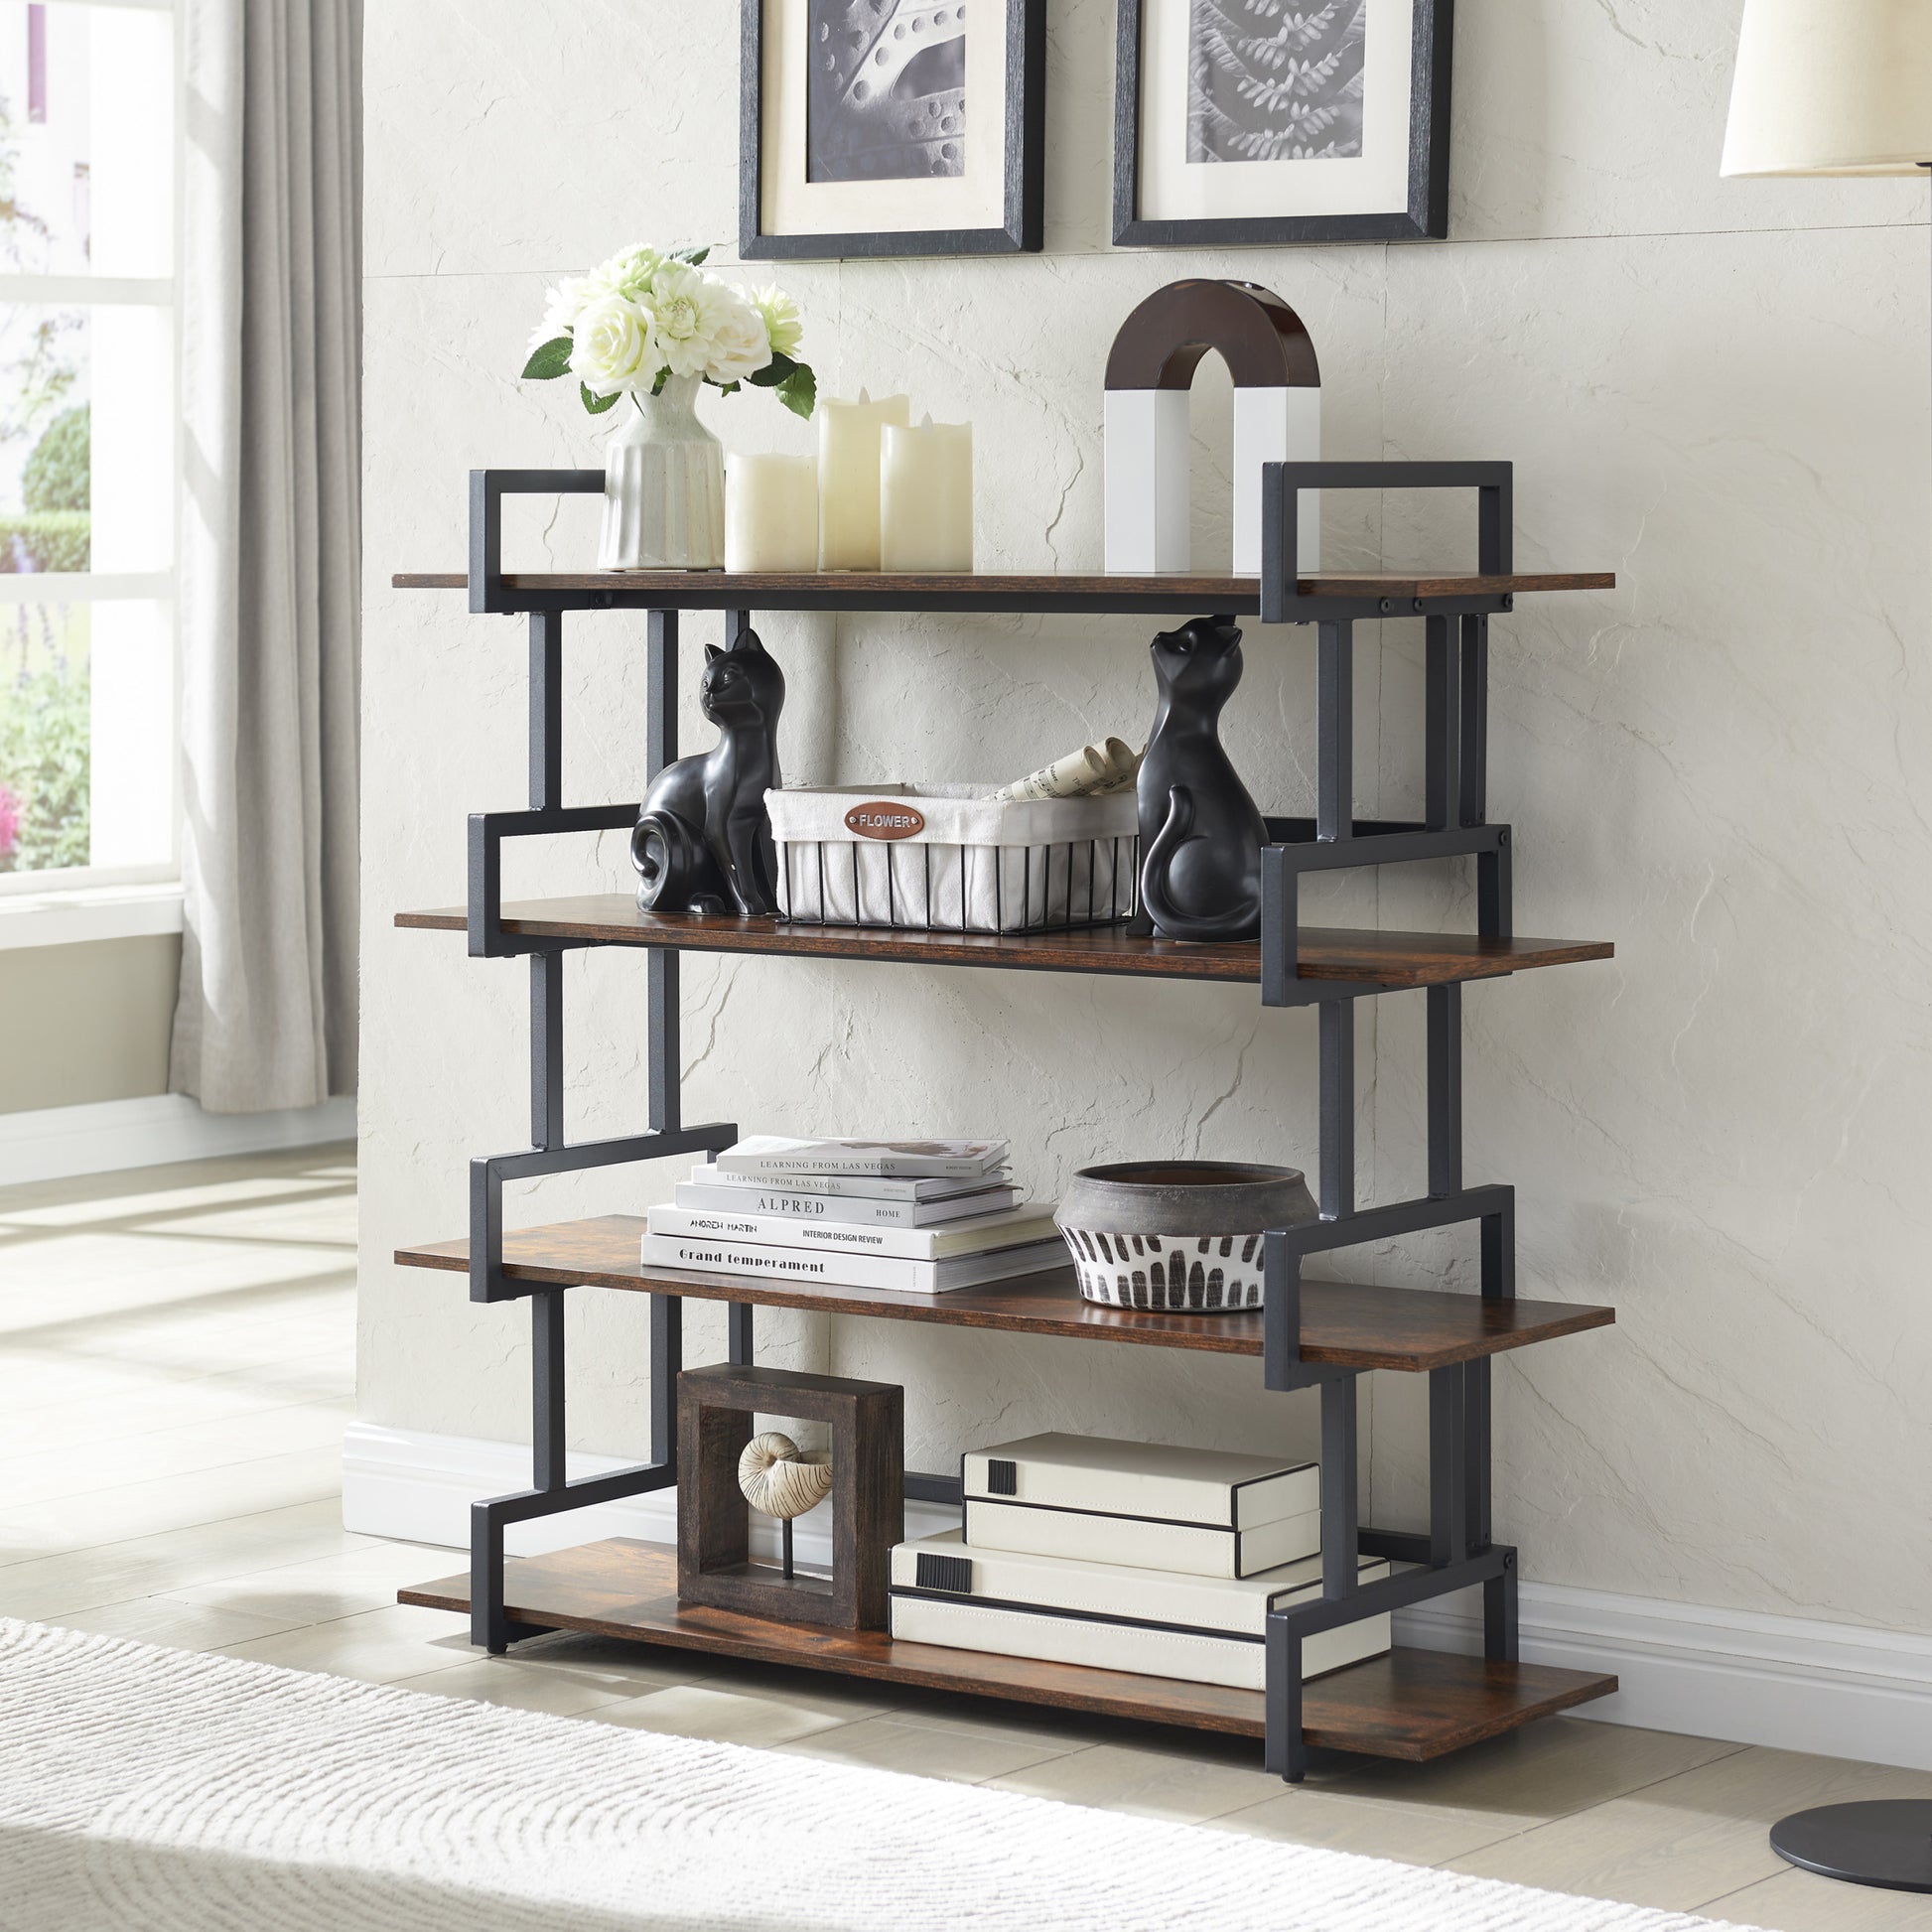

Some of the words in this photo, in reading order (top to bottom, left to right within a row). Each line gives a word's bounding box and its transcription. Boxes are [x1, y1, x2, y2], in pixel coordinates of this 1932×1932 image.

[859, 813, 910, 828] FLOWER
[726, 1174, 768, 1184] LEARNING
[770, 1177, 793, 1186] FROM
[795, 1179, 811, 1188] LAS
[813, 1181, 842, 1190] VEGAS
[758, 1197, 825, 1214] ALPRED
[876, 1209, 900, 1218] HOME
[727, 1223, 758, 1233] MARTIN
[802, 1229, 833, 1240] INTERIOR
[832, 1232, 858, 1243] DESIGN
[858, 1234, 884, 1245] REVIEW
[679, 1249, 723, 1263] Grand
[727, 1253, 825, 1273] temperament
